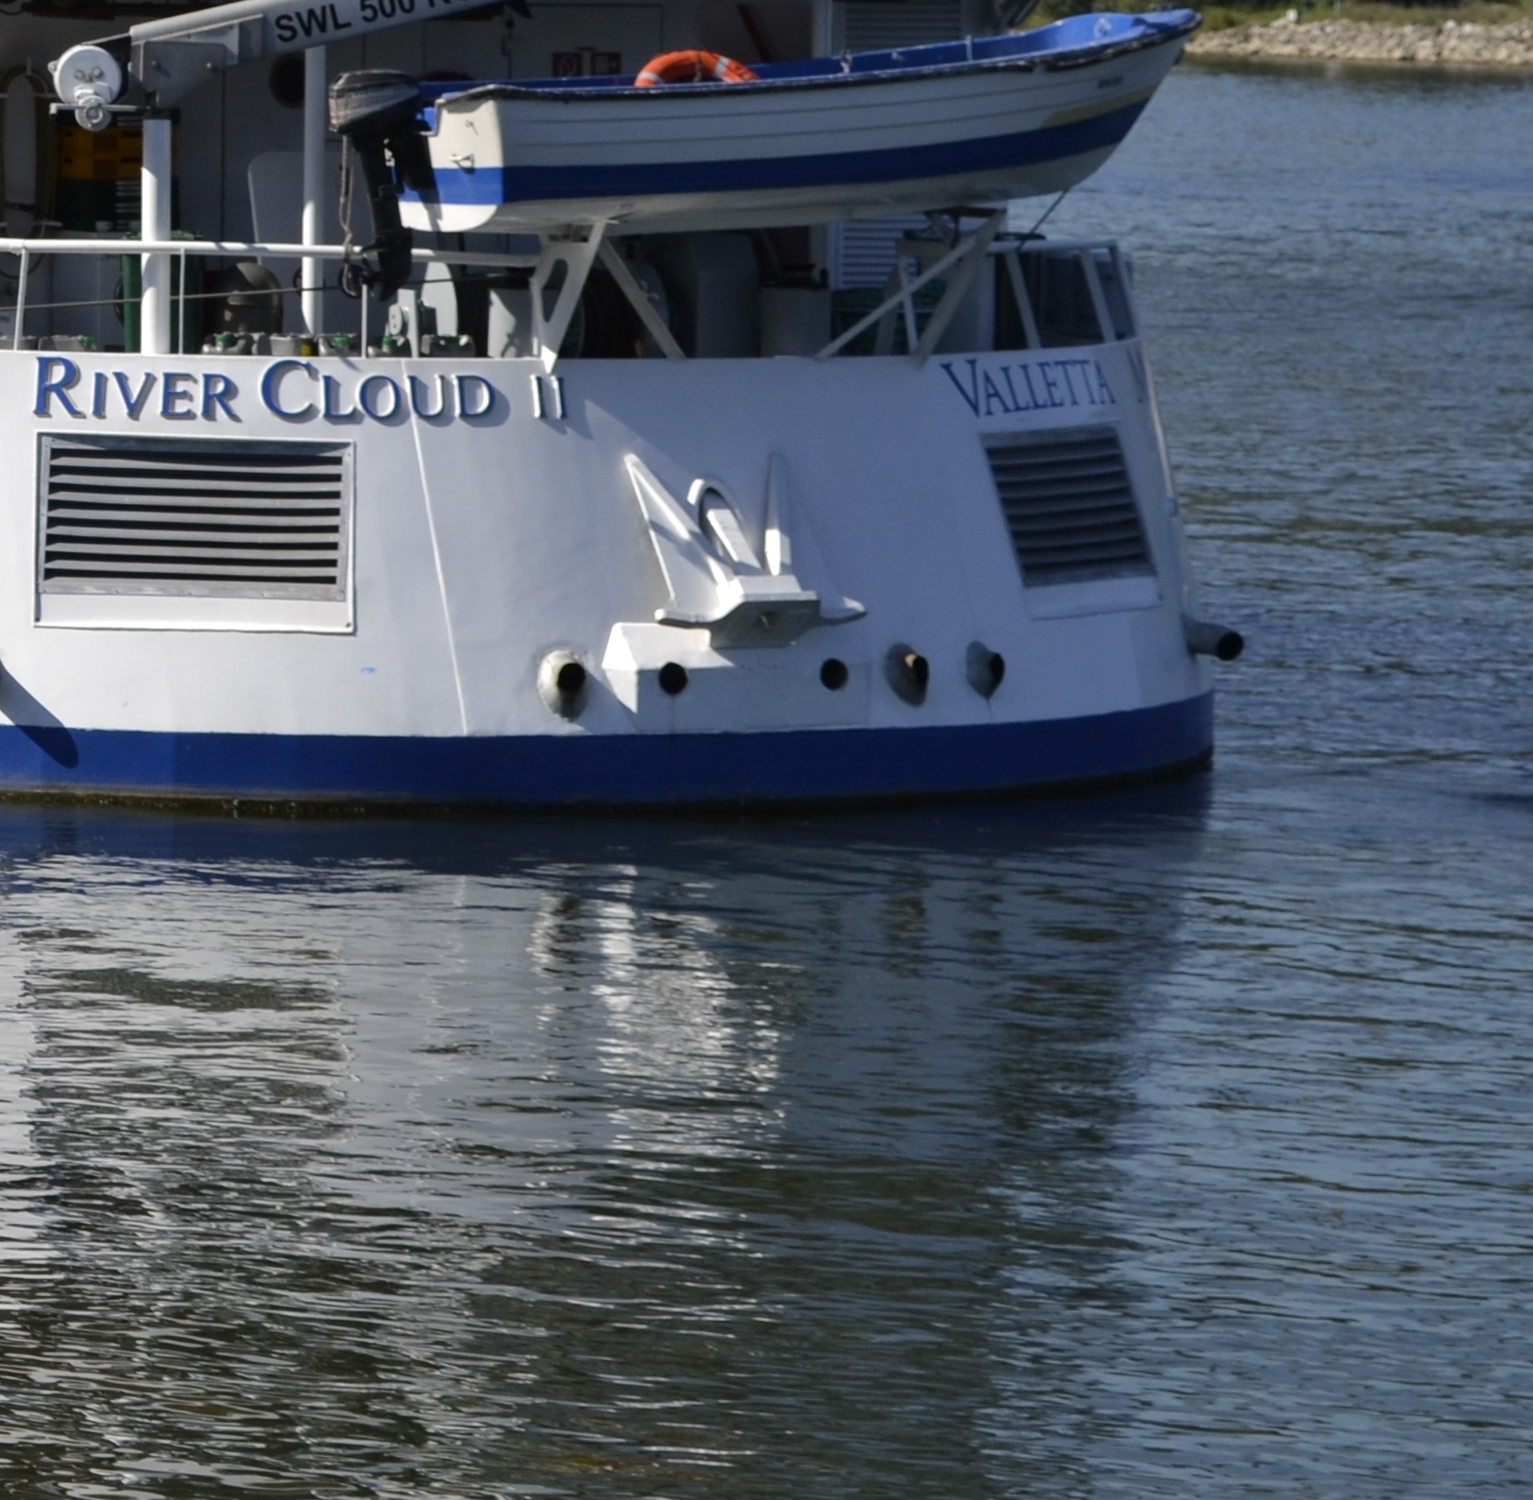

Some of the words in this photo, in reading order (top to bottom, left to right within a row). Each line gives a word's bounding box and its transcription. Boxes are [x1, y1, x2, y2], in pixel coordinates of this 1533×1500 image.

[274, 3, 352, 43] SWL
[32, 356, 242, 422] RIVER
[258, 358, 498, 423] CLOUD
[530, 373, 567, 420] II
[939, 357, 1117, 419] VALLETTA
